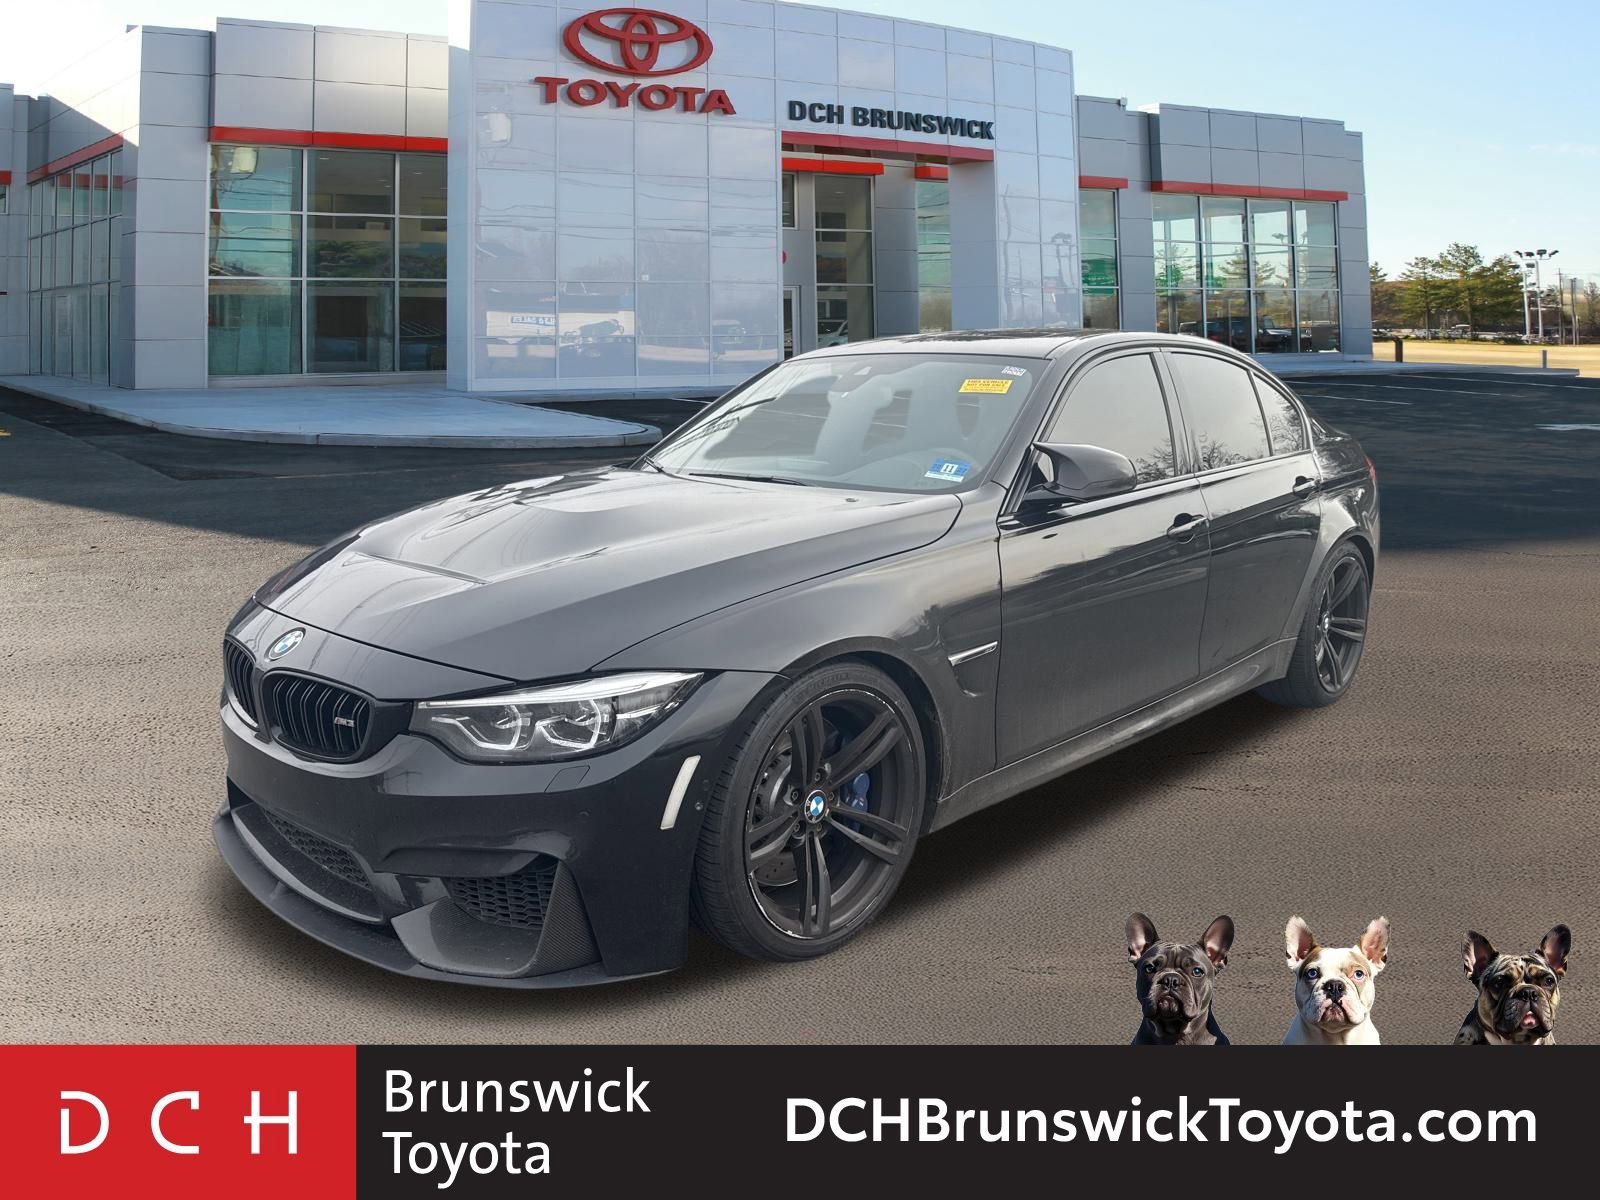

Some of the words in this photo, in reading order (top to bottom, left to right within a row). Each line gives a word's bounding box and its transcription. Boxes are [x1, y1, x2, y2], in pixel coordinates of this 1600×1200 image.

[534, 76, 736, 115] TOYOTA
[788, 100, 844, 124] DCH
[852, 106, 995, 139] BRUNSWICK
